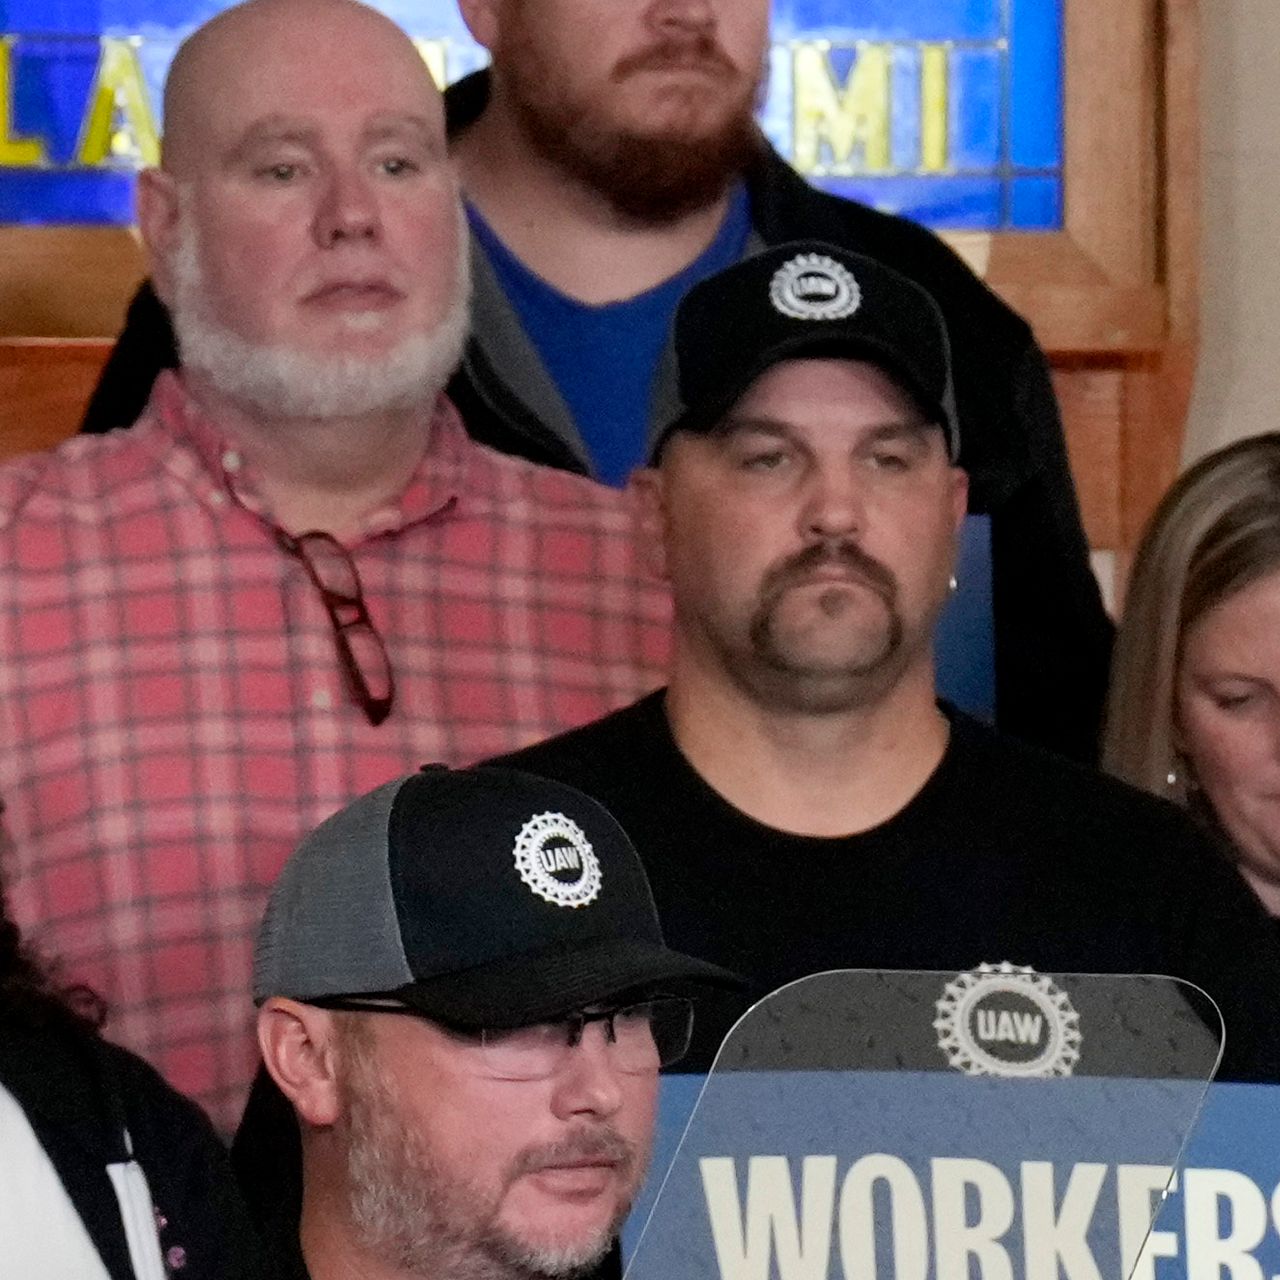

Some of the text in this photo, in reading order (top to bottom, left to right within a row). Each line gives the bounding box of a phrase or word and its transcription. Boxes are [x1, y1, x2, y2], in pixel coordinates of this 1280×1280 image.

[791, 40, 950, 175] MI
[540, 846, 580, 872] UAW
[976, 1009, 1042, 1045] UAW
